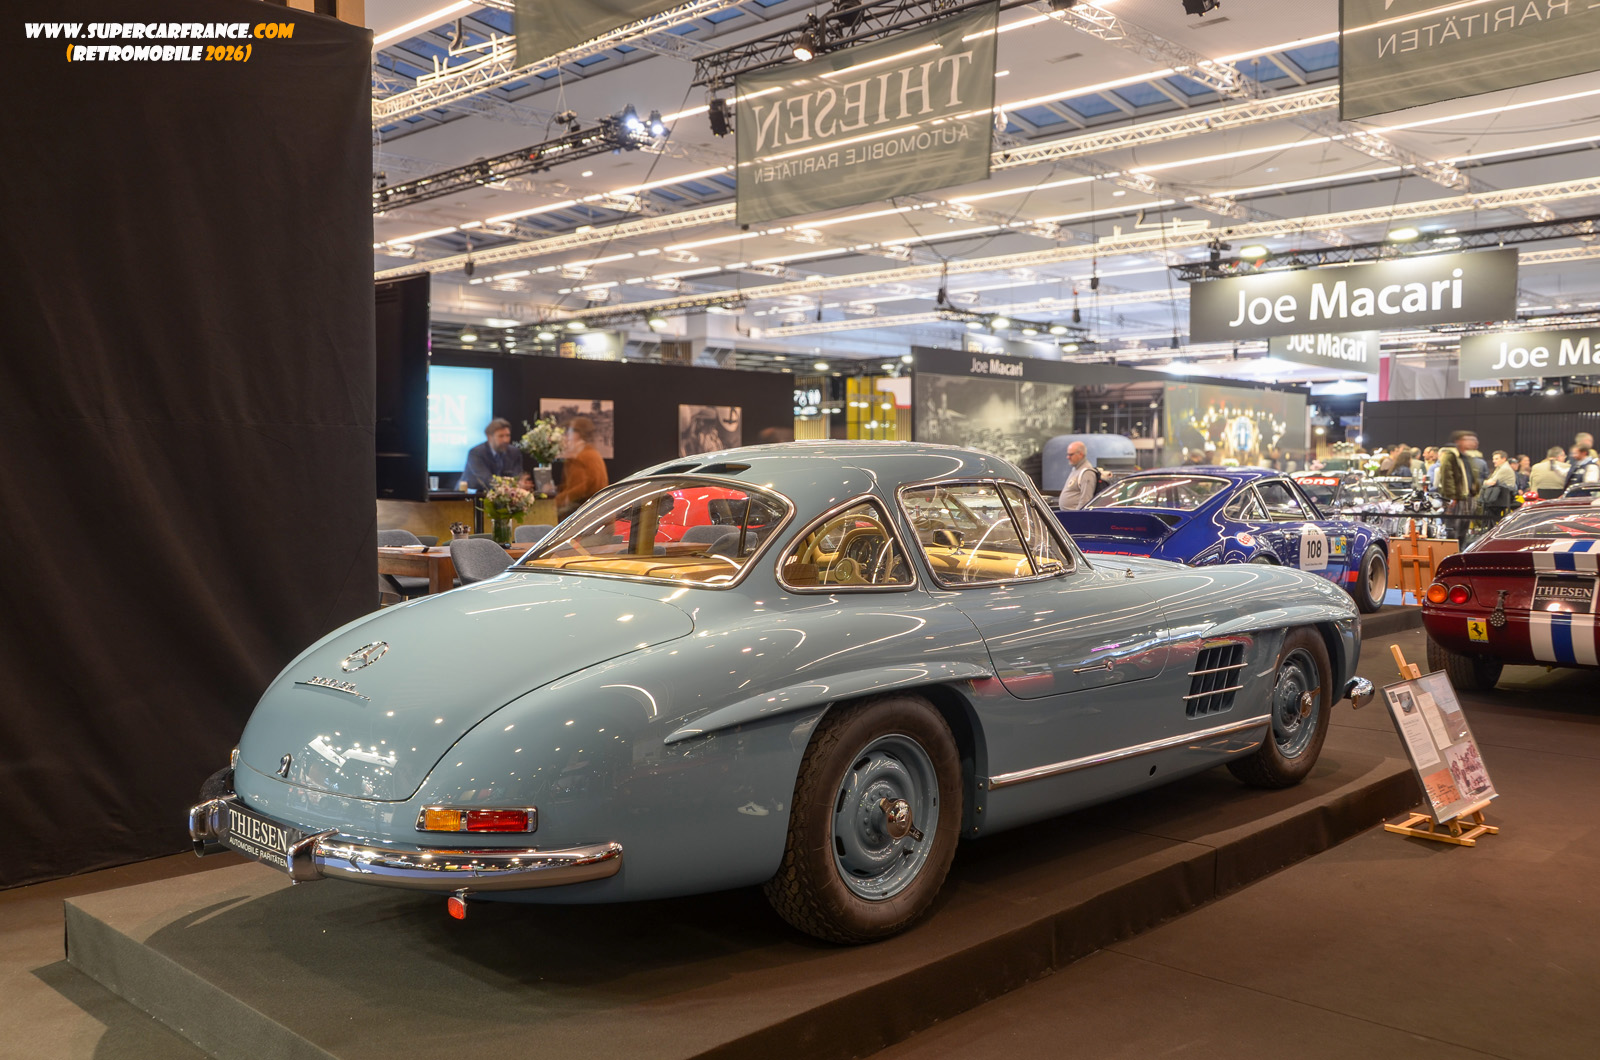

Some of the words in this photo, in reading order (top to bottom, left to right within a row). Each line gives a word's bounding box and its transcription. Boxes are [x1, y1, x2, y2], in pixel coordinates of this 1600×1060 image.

[1229, 290, 1297, 327] Joe
[1309, 268, 1463, 321] Macari
[1286, 334, 1315, 354] Joe
[1491, 341, 1549, 370] Joe
[970, 357, 988, 373] Joe
[989, 358, 1023, 377] Macari
[1296, 477, 1336, 485] fone
[1307, 540, 1322, 559] 108
[1536, 586, 1593, 598] THIESEN
[229, 808, 288, 853] THIESEN
[229, 836, 259, 856] AUTOMOBILE
[259, 850, 288, 868] RARITÄTEN
